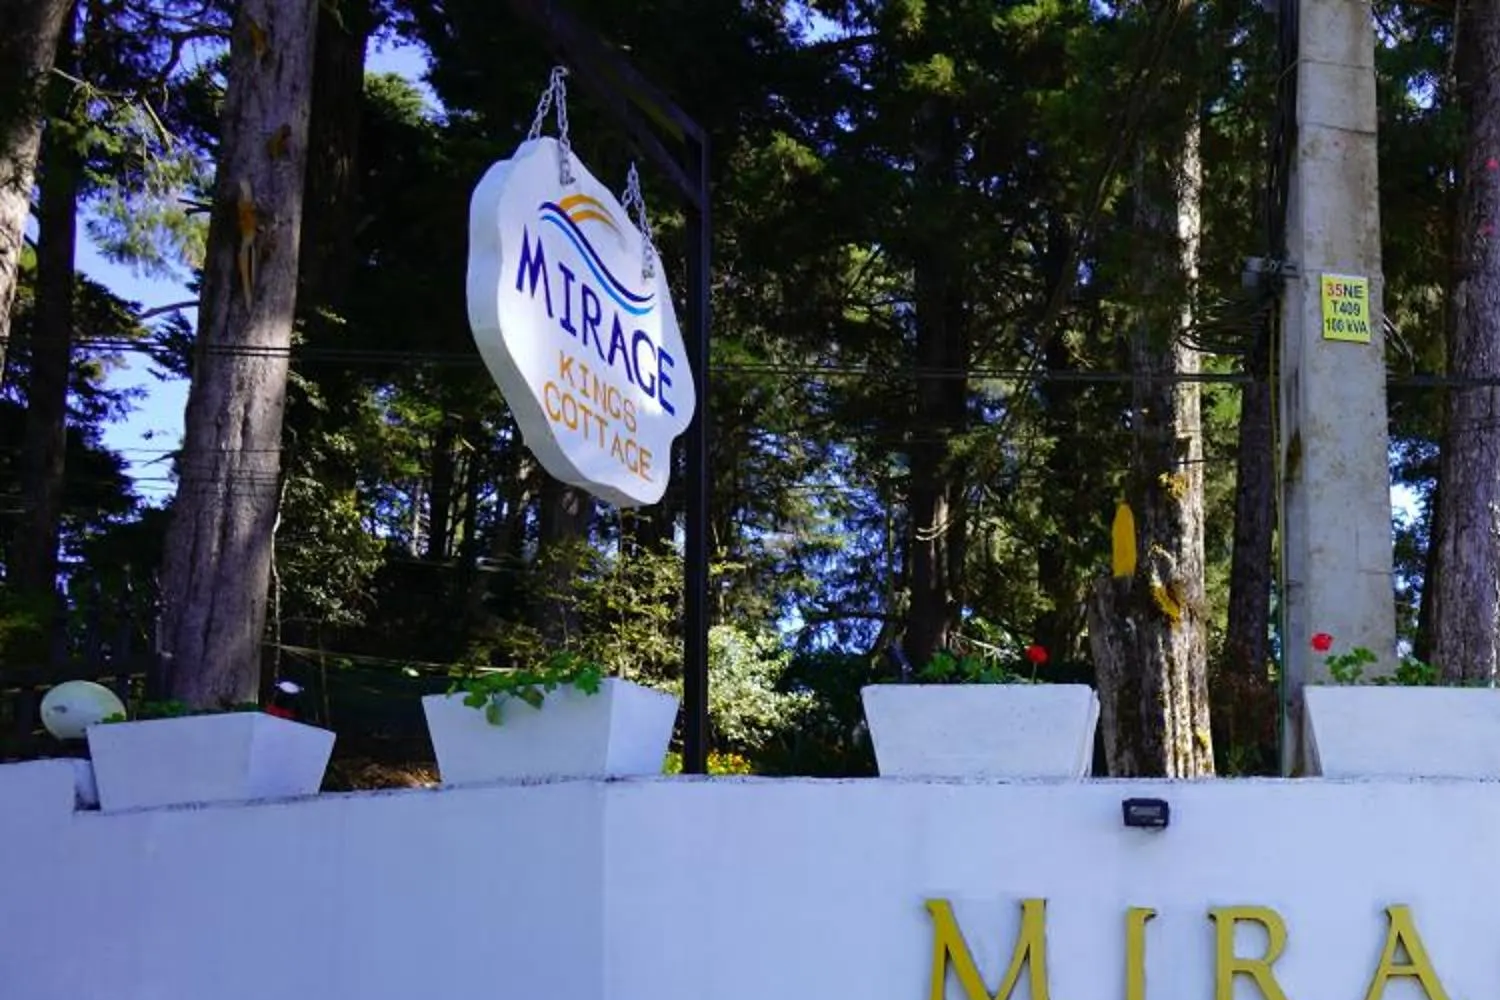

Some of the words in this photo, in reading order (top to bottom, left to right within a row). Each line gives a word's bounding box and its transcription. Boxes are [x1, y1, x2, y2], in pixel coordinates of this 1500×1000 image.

[515, 224, 676, 417] MIRAGE
[1327, 283, 1364, 298] 35NE
[542, 380, 654, 483] COTTAGE
[559, 350, 638, 433] KINGS
